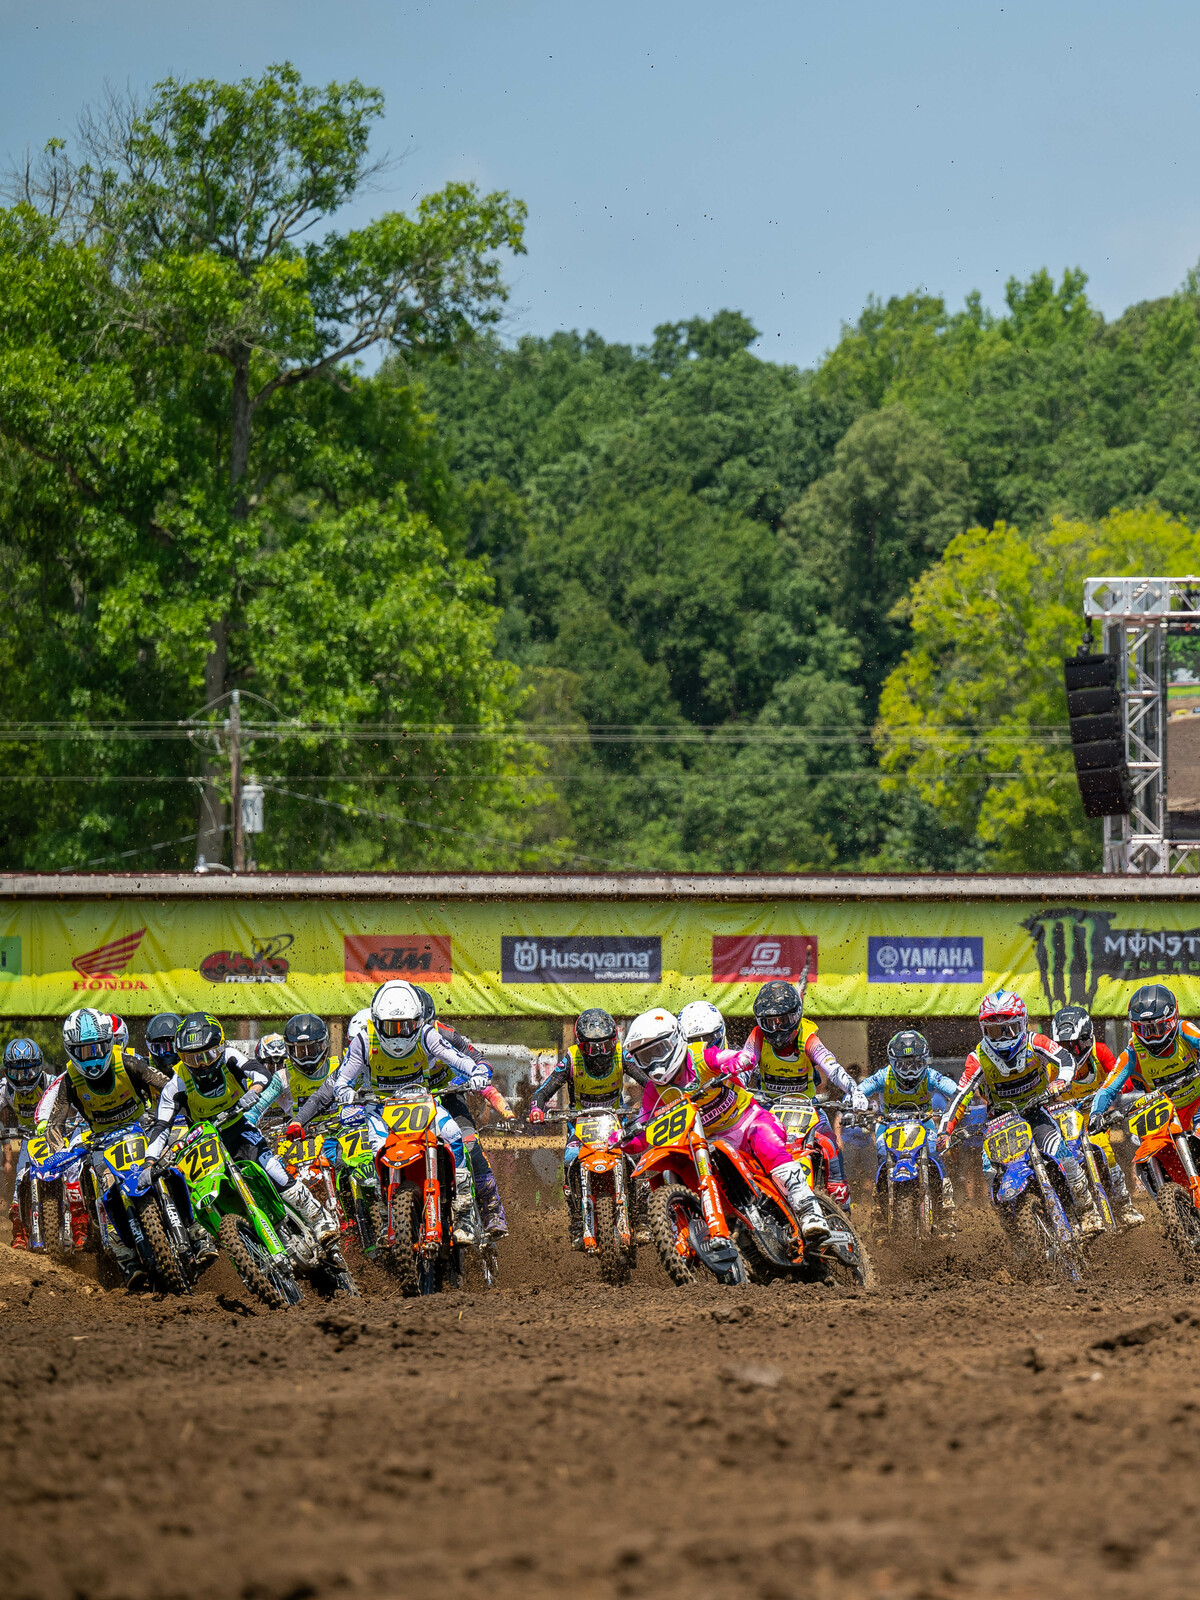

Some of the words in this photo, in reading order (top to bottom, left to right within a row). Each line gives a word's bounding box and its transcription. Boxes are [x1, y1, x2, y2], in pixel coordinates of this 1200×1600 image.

[365, 947, 432, 970] KTM
[541, 948, 650, 972] Husqvarna
[900, 948, 974, 968] YAMAHA
[72, 980, 149, 991] HONDA
[391, 1105, 431, 1133] 20
[700, 1090, 735, 1125] HAMPIONSHIP
[1131, 1102, 1170, 1137] 16
[653, 1108, 688, 1147] 28
[110, 1138, 146, 1170] 19
[186, 1139, 220, 1183] 29
